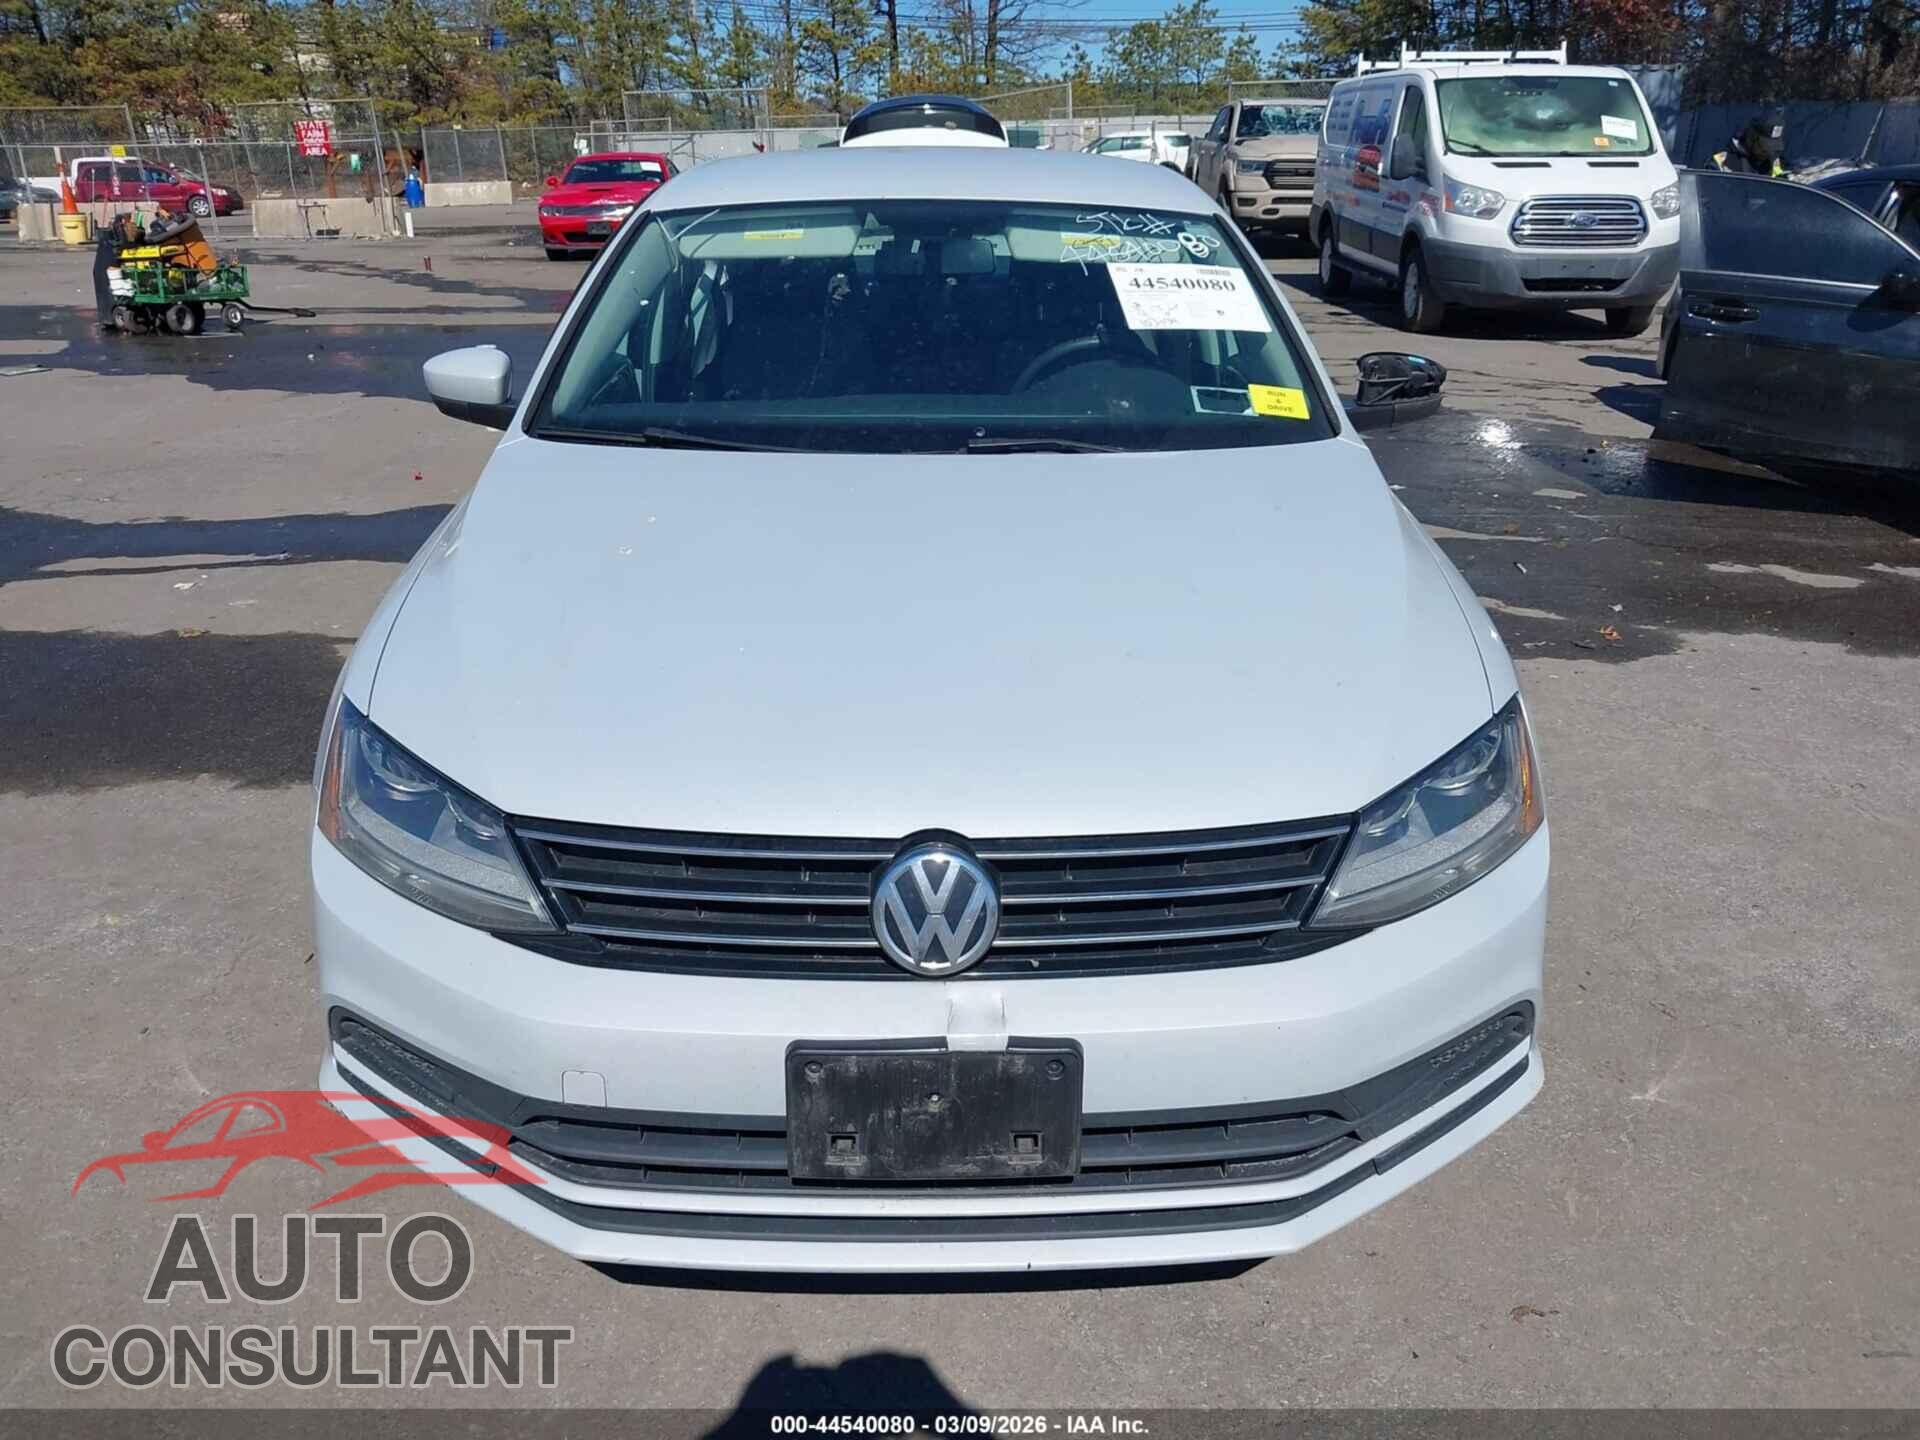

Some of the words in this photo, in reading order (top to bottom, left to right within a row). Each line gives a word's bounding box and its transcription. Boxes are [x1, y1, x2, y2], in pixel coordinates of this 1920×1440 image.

[299, 121, 324, 129] STATE
[305, 147, 328, 156] AREA
[1128, 276, 1236, 292] 44540080
